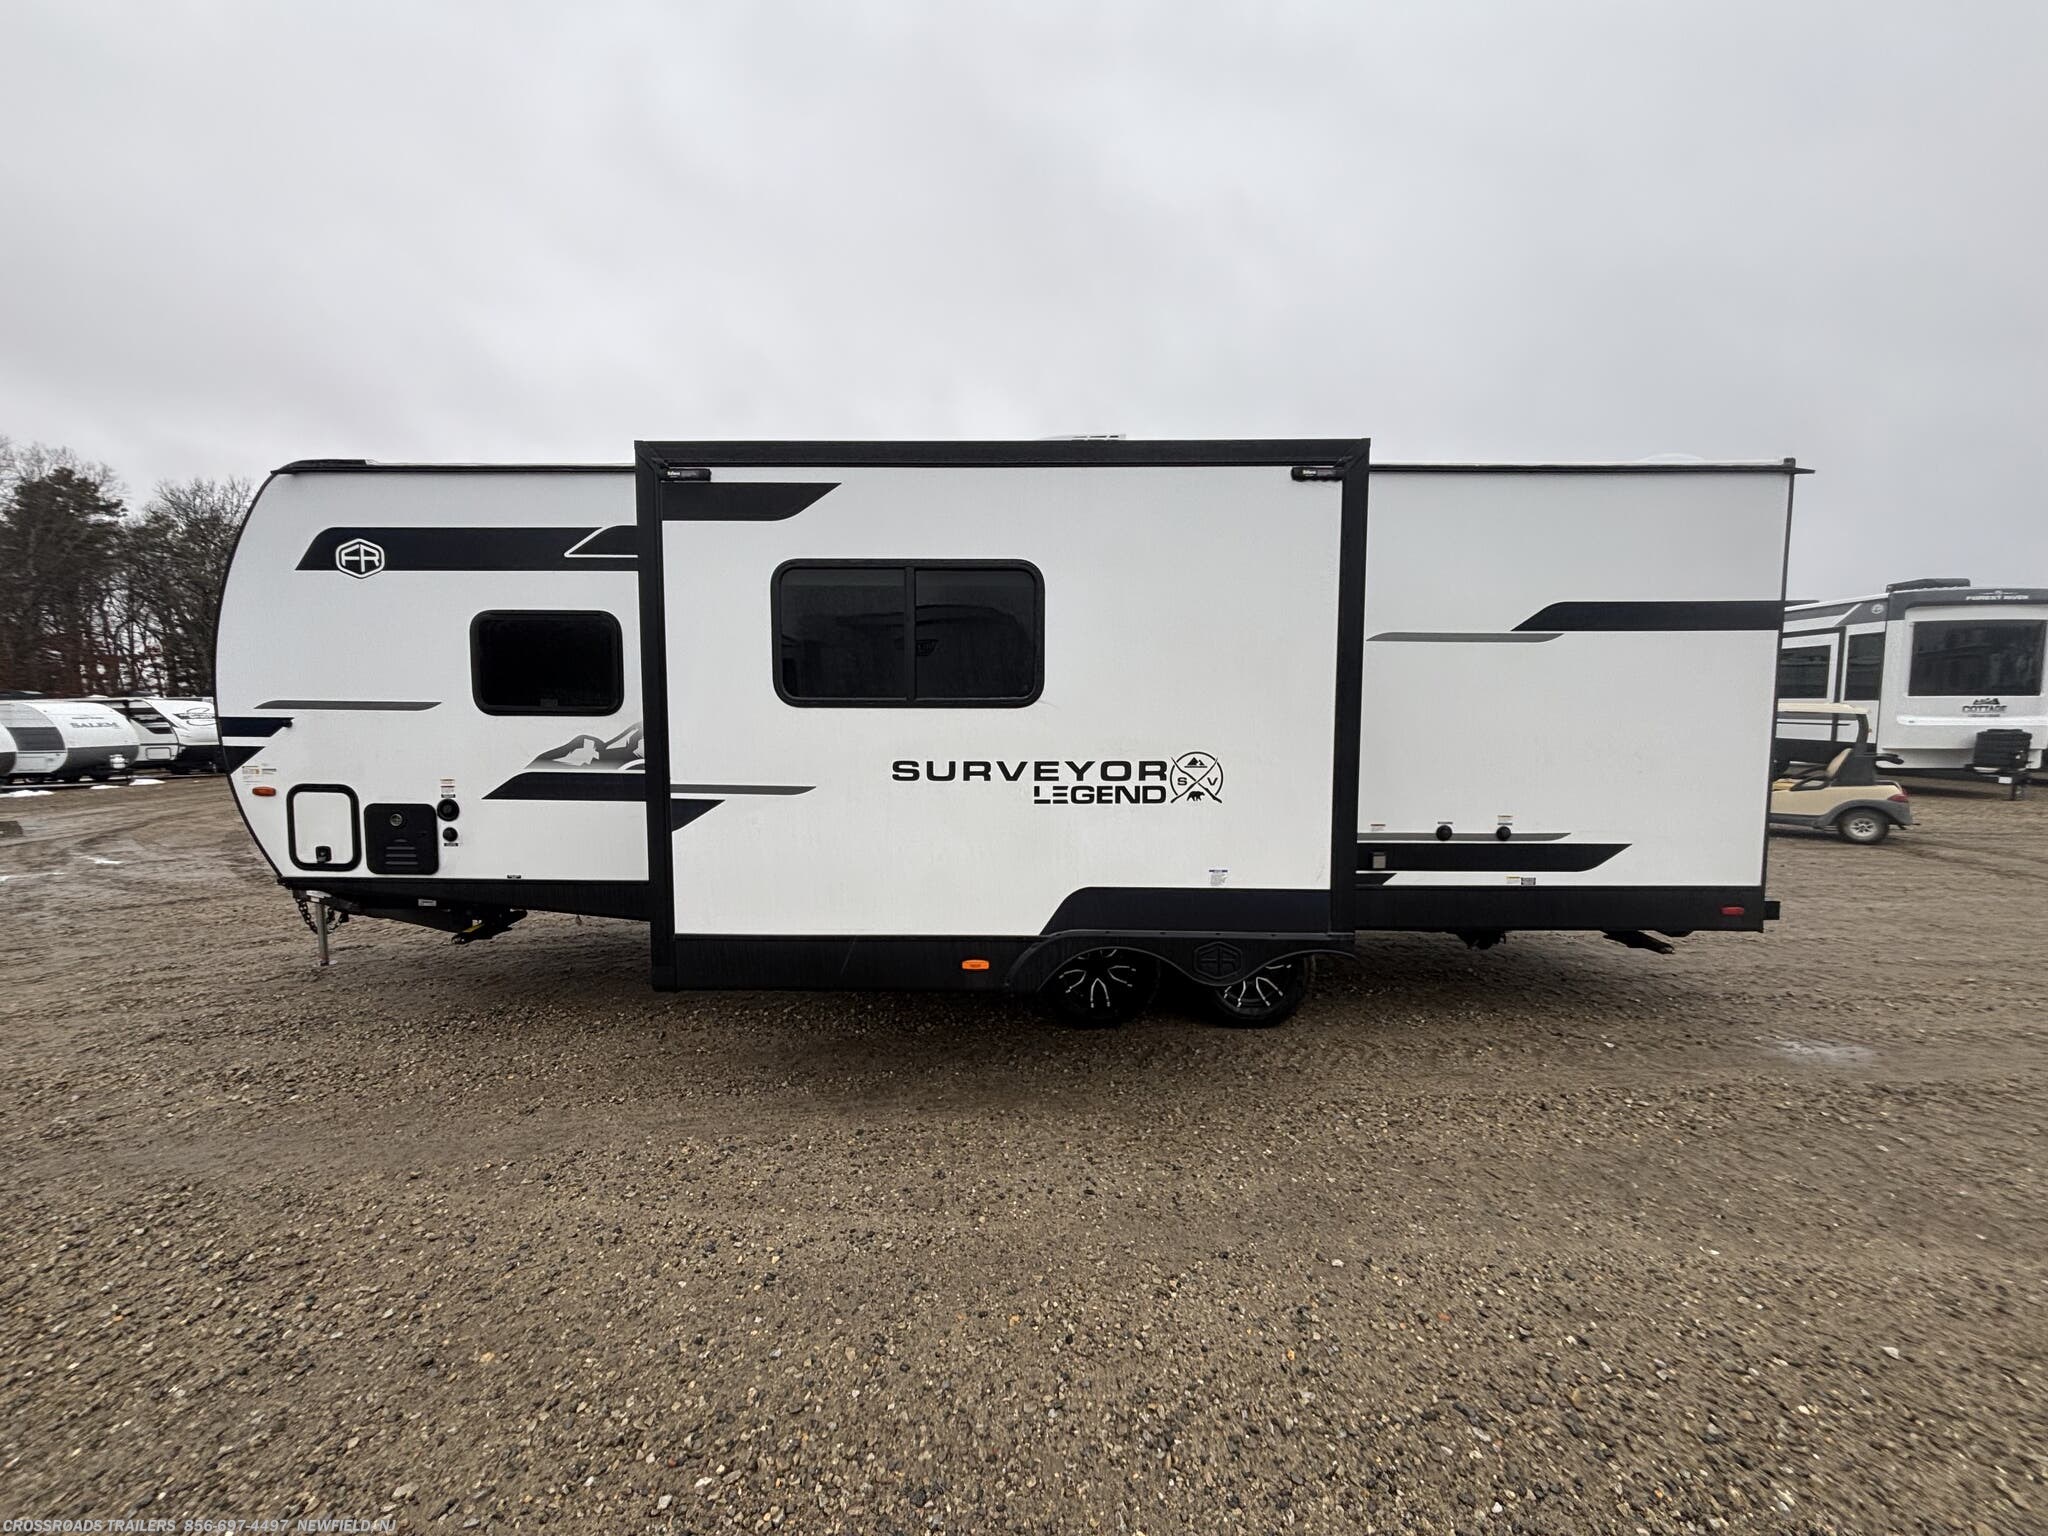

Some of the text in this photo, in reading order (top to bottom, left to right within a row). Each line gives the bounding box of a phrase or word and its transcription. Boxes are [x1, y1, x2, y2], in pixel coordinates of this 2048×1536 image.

[892, 760, 1167, 782] SURVEYOR
[1177, 777, 1218, 786] S V
[1033, 785, 1167, 804] LEGEND
